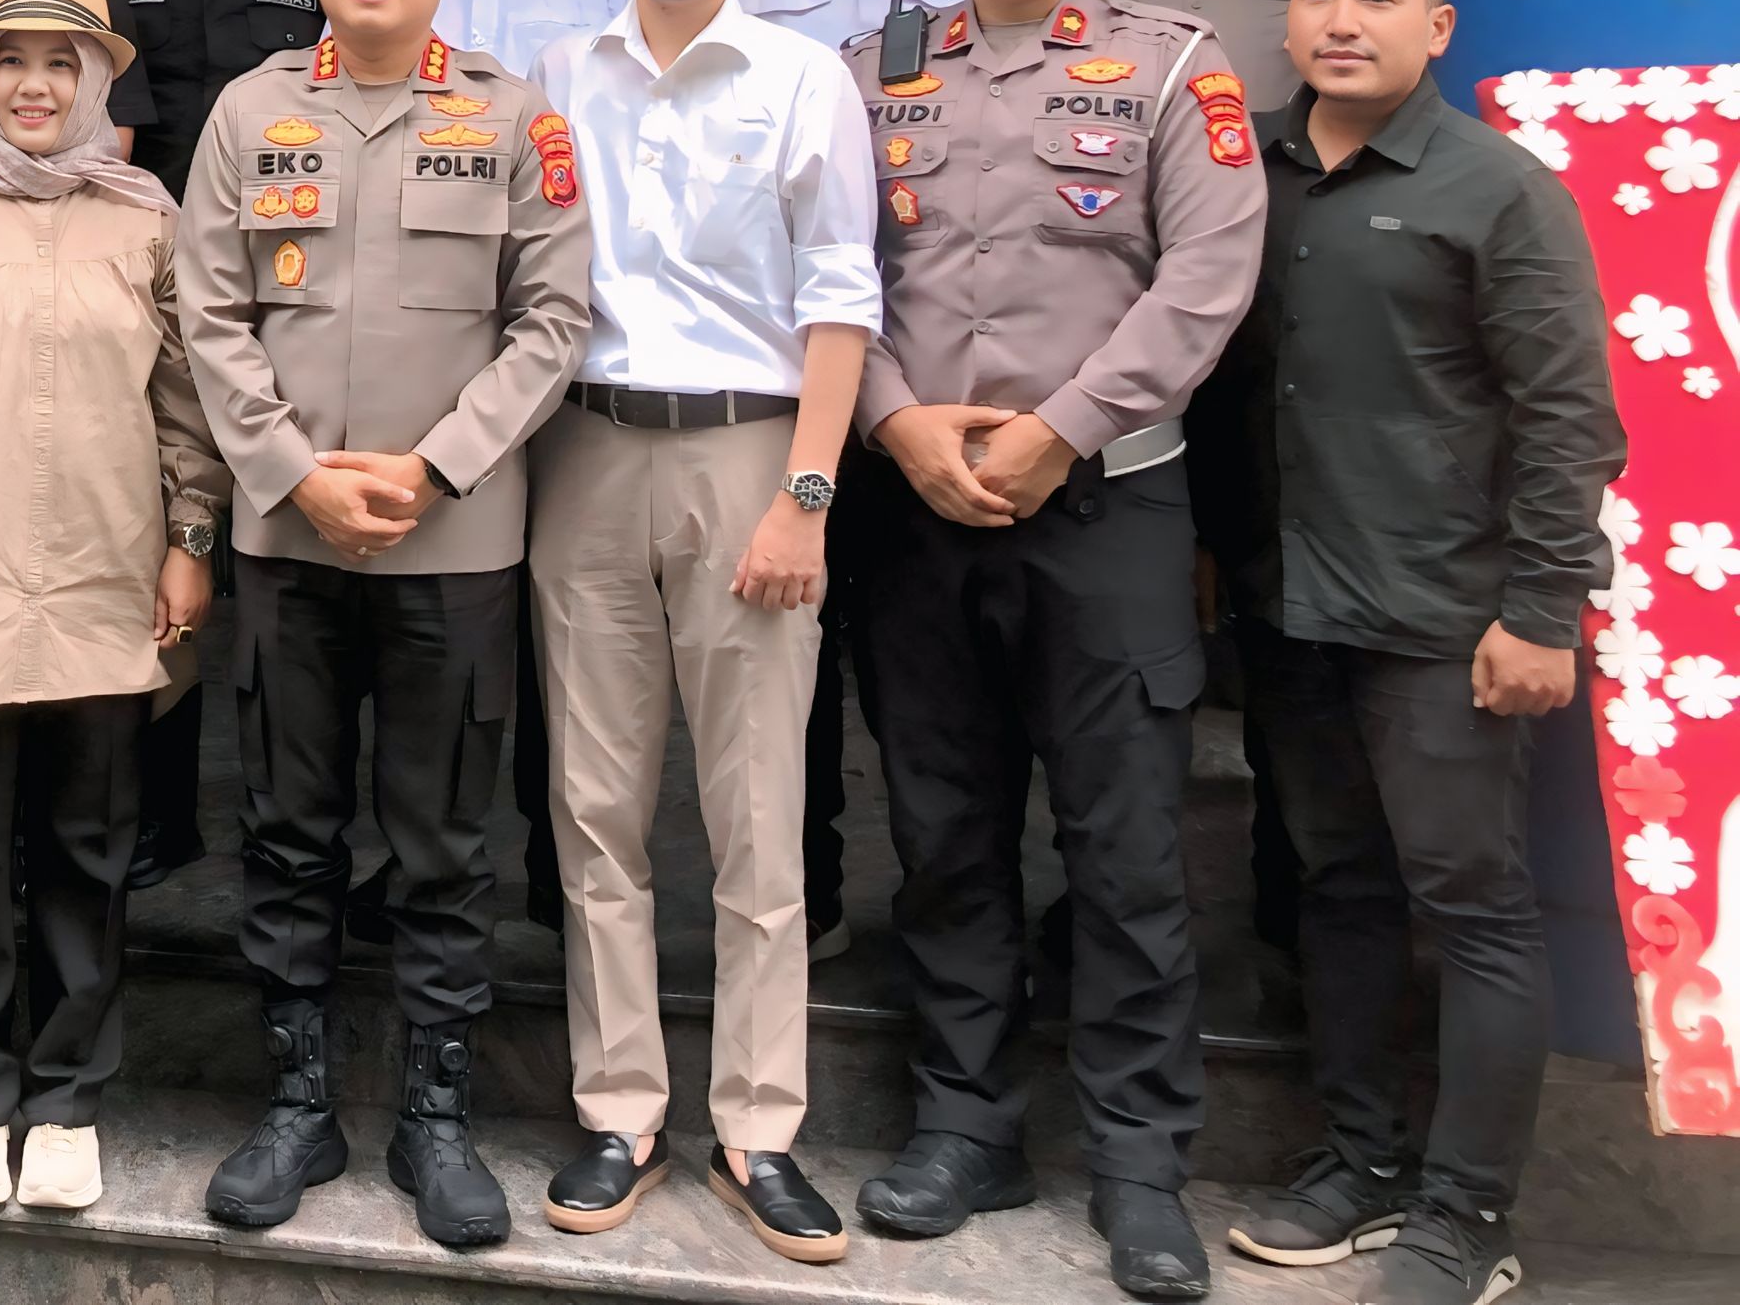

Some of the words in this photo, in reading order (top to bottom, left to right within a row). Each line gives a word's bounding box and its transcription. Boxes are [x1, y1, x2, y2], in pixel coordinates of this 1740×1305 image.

[866, 104, 943, 128] YUDI
[1044, 95, 1144, 123] POLRI
[257, 151, 323, 175] EKO
[415, 154, 497, 180] POLRI
